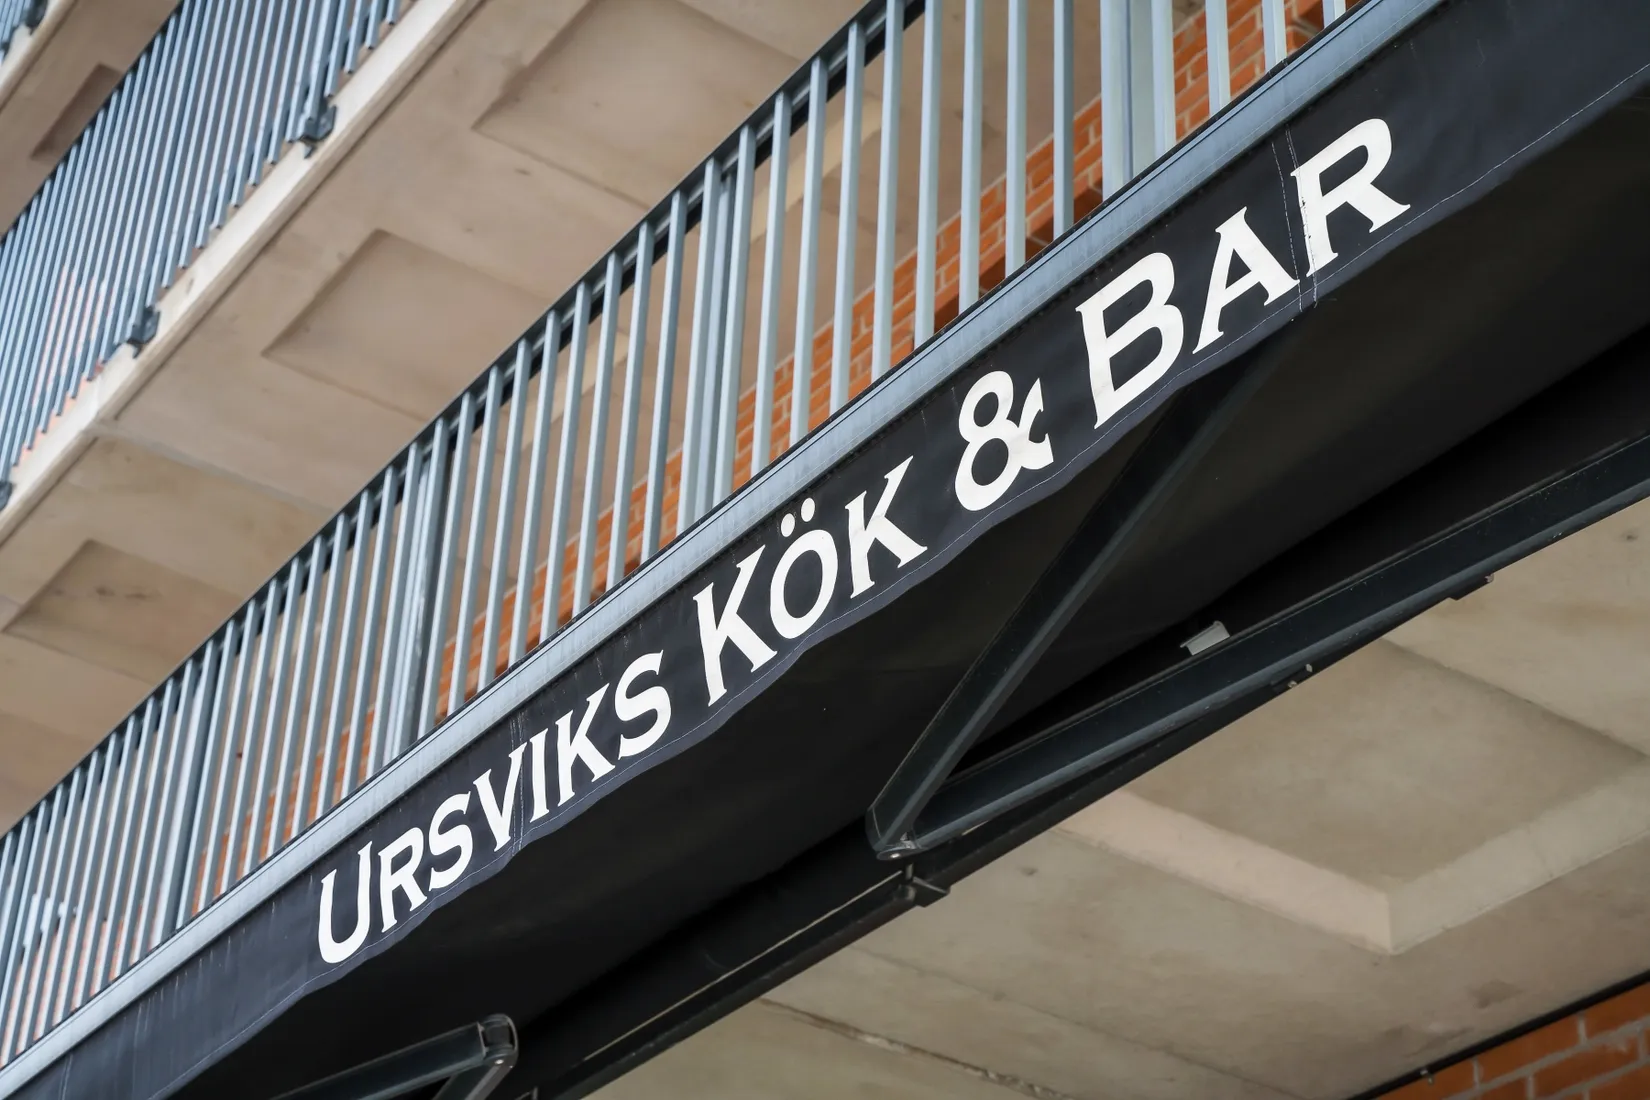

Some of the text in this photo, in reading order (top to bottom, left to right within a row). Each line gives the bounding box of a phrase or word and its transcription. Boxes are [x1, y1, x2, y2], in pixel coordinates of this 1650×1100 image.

[317, 118, 1411, 965] URSVIKS KÖK & BAR
